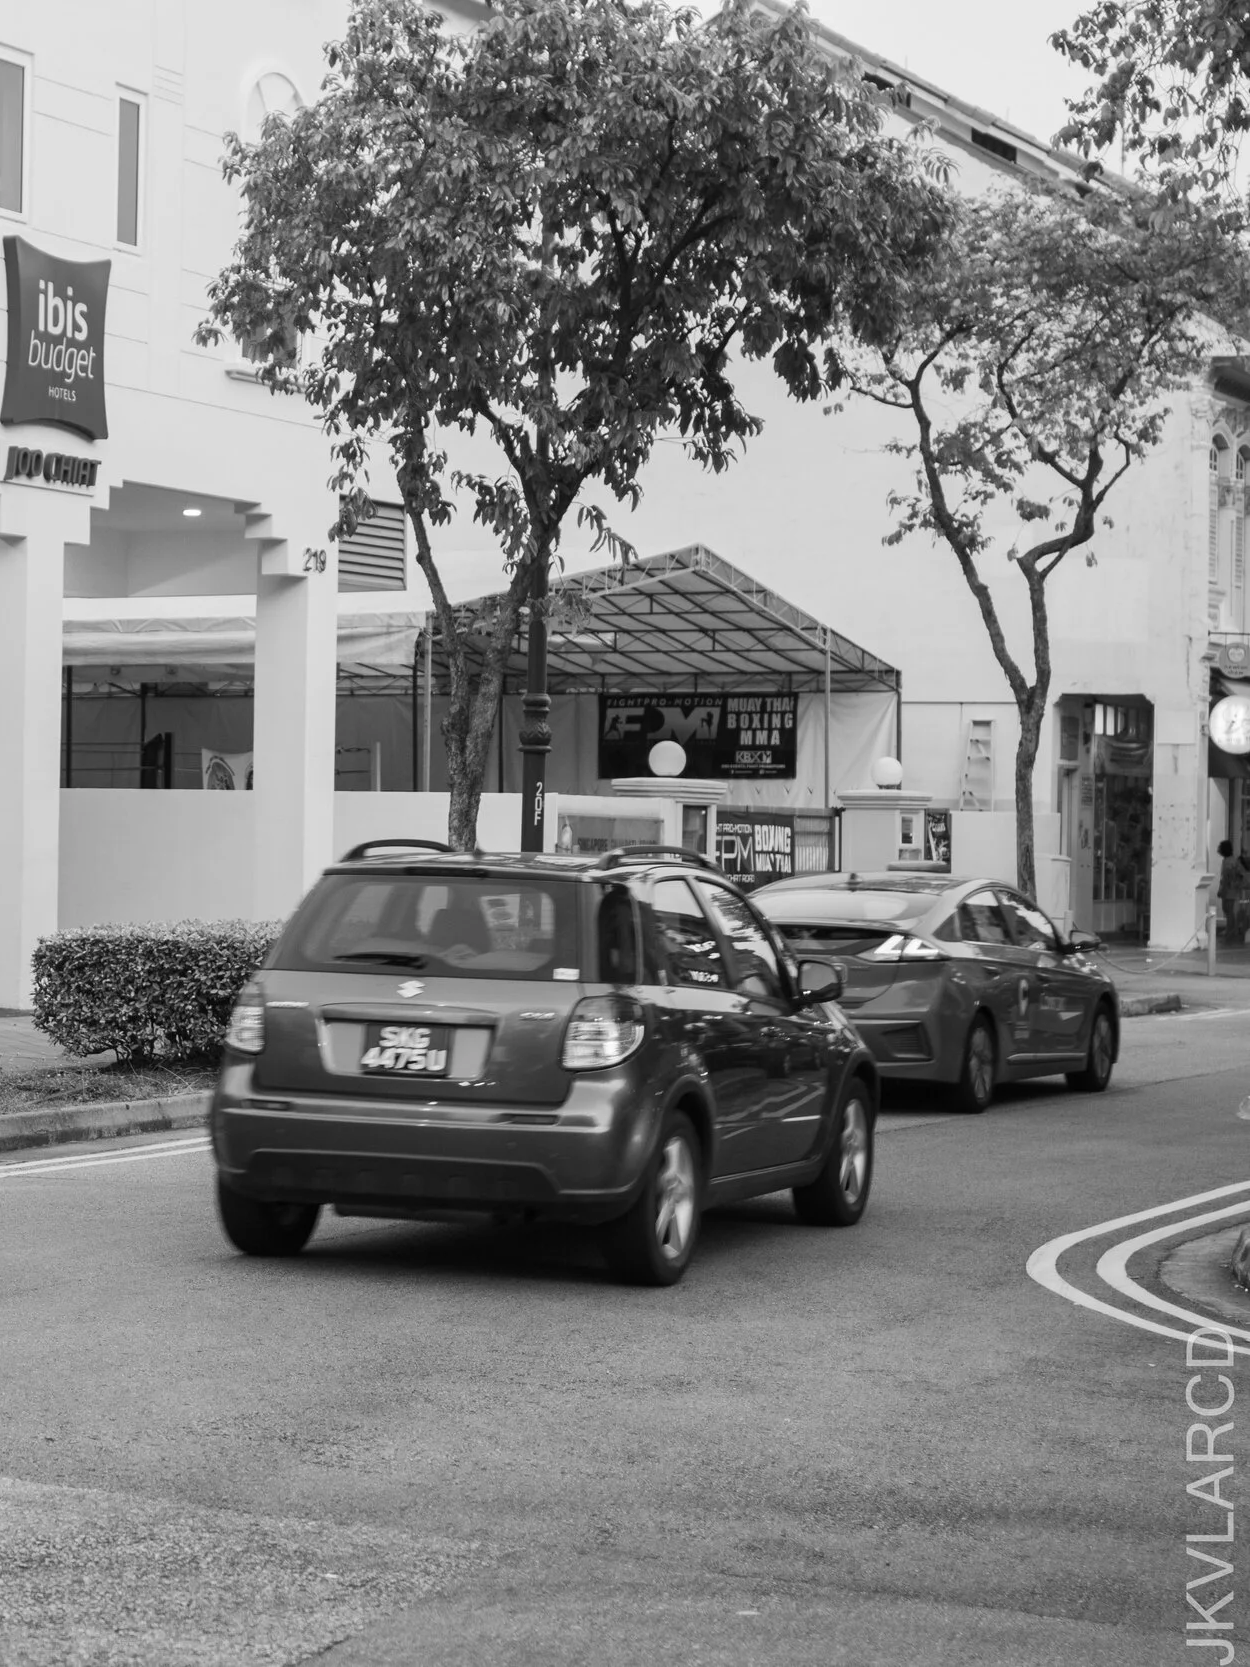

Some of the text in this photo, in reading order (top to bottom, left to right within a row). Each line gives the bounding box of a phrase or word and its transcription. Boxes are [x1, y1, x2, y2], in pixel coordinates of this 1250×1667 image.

[38, 279, 89, 342] ibis
[28, 330, 97, 383] budget
[48, 385, 77, 402] HOTELS
[3, 446, 102, 488] JOO CHIAT
[727, 696, 795, 712] MUAY THAI
[727, 712, 794, 729] BOXING
[740, 729, 781, 746] MMA
[754, 824, 792, 853] BOXING
[360, 1046, 447, 1071] 4475U
